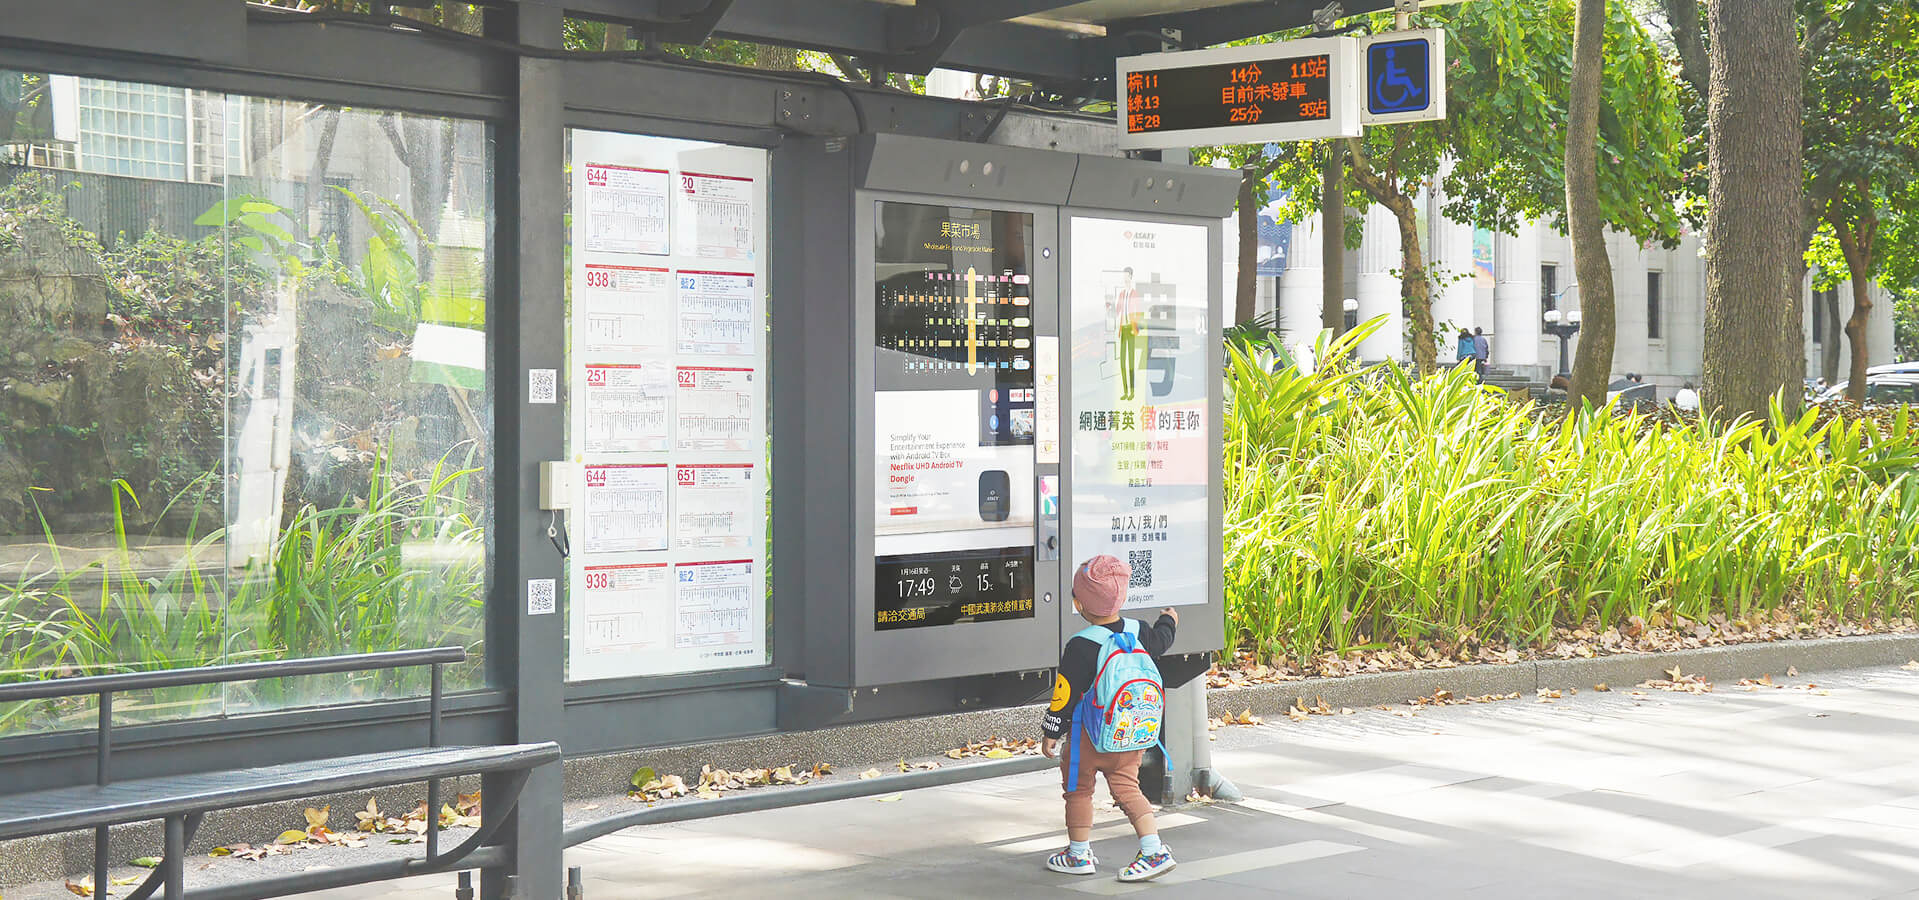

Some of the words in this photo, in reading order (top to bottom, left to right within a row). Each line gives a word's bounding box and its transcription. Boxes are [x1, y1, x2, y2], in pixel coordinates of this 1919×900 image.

[1128, 72, 1158, 93] 棕11
[1231, 63, 1262, 84] 14分
[1291, 56, 1327, 79] 11站
[1128, 95, 1160, 112] 綠13
[1222, 81, 1308, 105] 目前未發車
[1128, 114, 1160, 132] 藍28
[1230, 104, 1263, 123] 25分
[1299, 98, 1327, 118] 3站
[587, 169, 607, 181] 644
[940, 221, 981, 240] 果菜市場
[587, 271, 608, 287] 938
[587, 369, 606, 381] 251
[678, 371, 695, 383] 621
[1079, 411, 1135, 431] 網通菁英
[890, 433, 917, 442] Simplify
[890, 443, 935, 451] Entertainment
[936, 441, 966, 450] Experience
[906, 452, 931, 460] Android
[890, 462, 914, 471] Netflix
[916, 462, 930, 470] UHD
[931, 461, 955, 469] Android
[956, 460, 964, 468] TV
[586, 470, 606, 482] 644
[677, 469, 695, 481] 651
[890, 474, 915, 484] Dongle
[586, 573, 608, 589] 938
[897, 577, 935, 598] 17:49
[1008, 572, 1014, 589] 1
[877, 607, 926, 623] 請洽交通局
